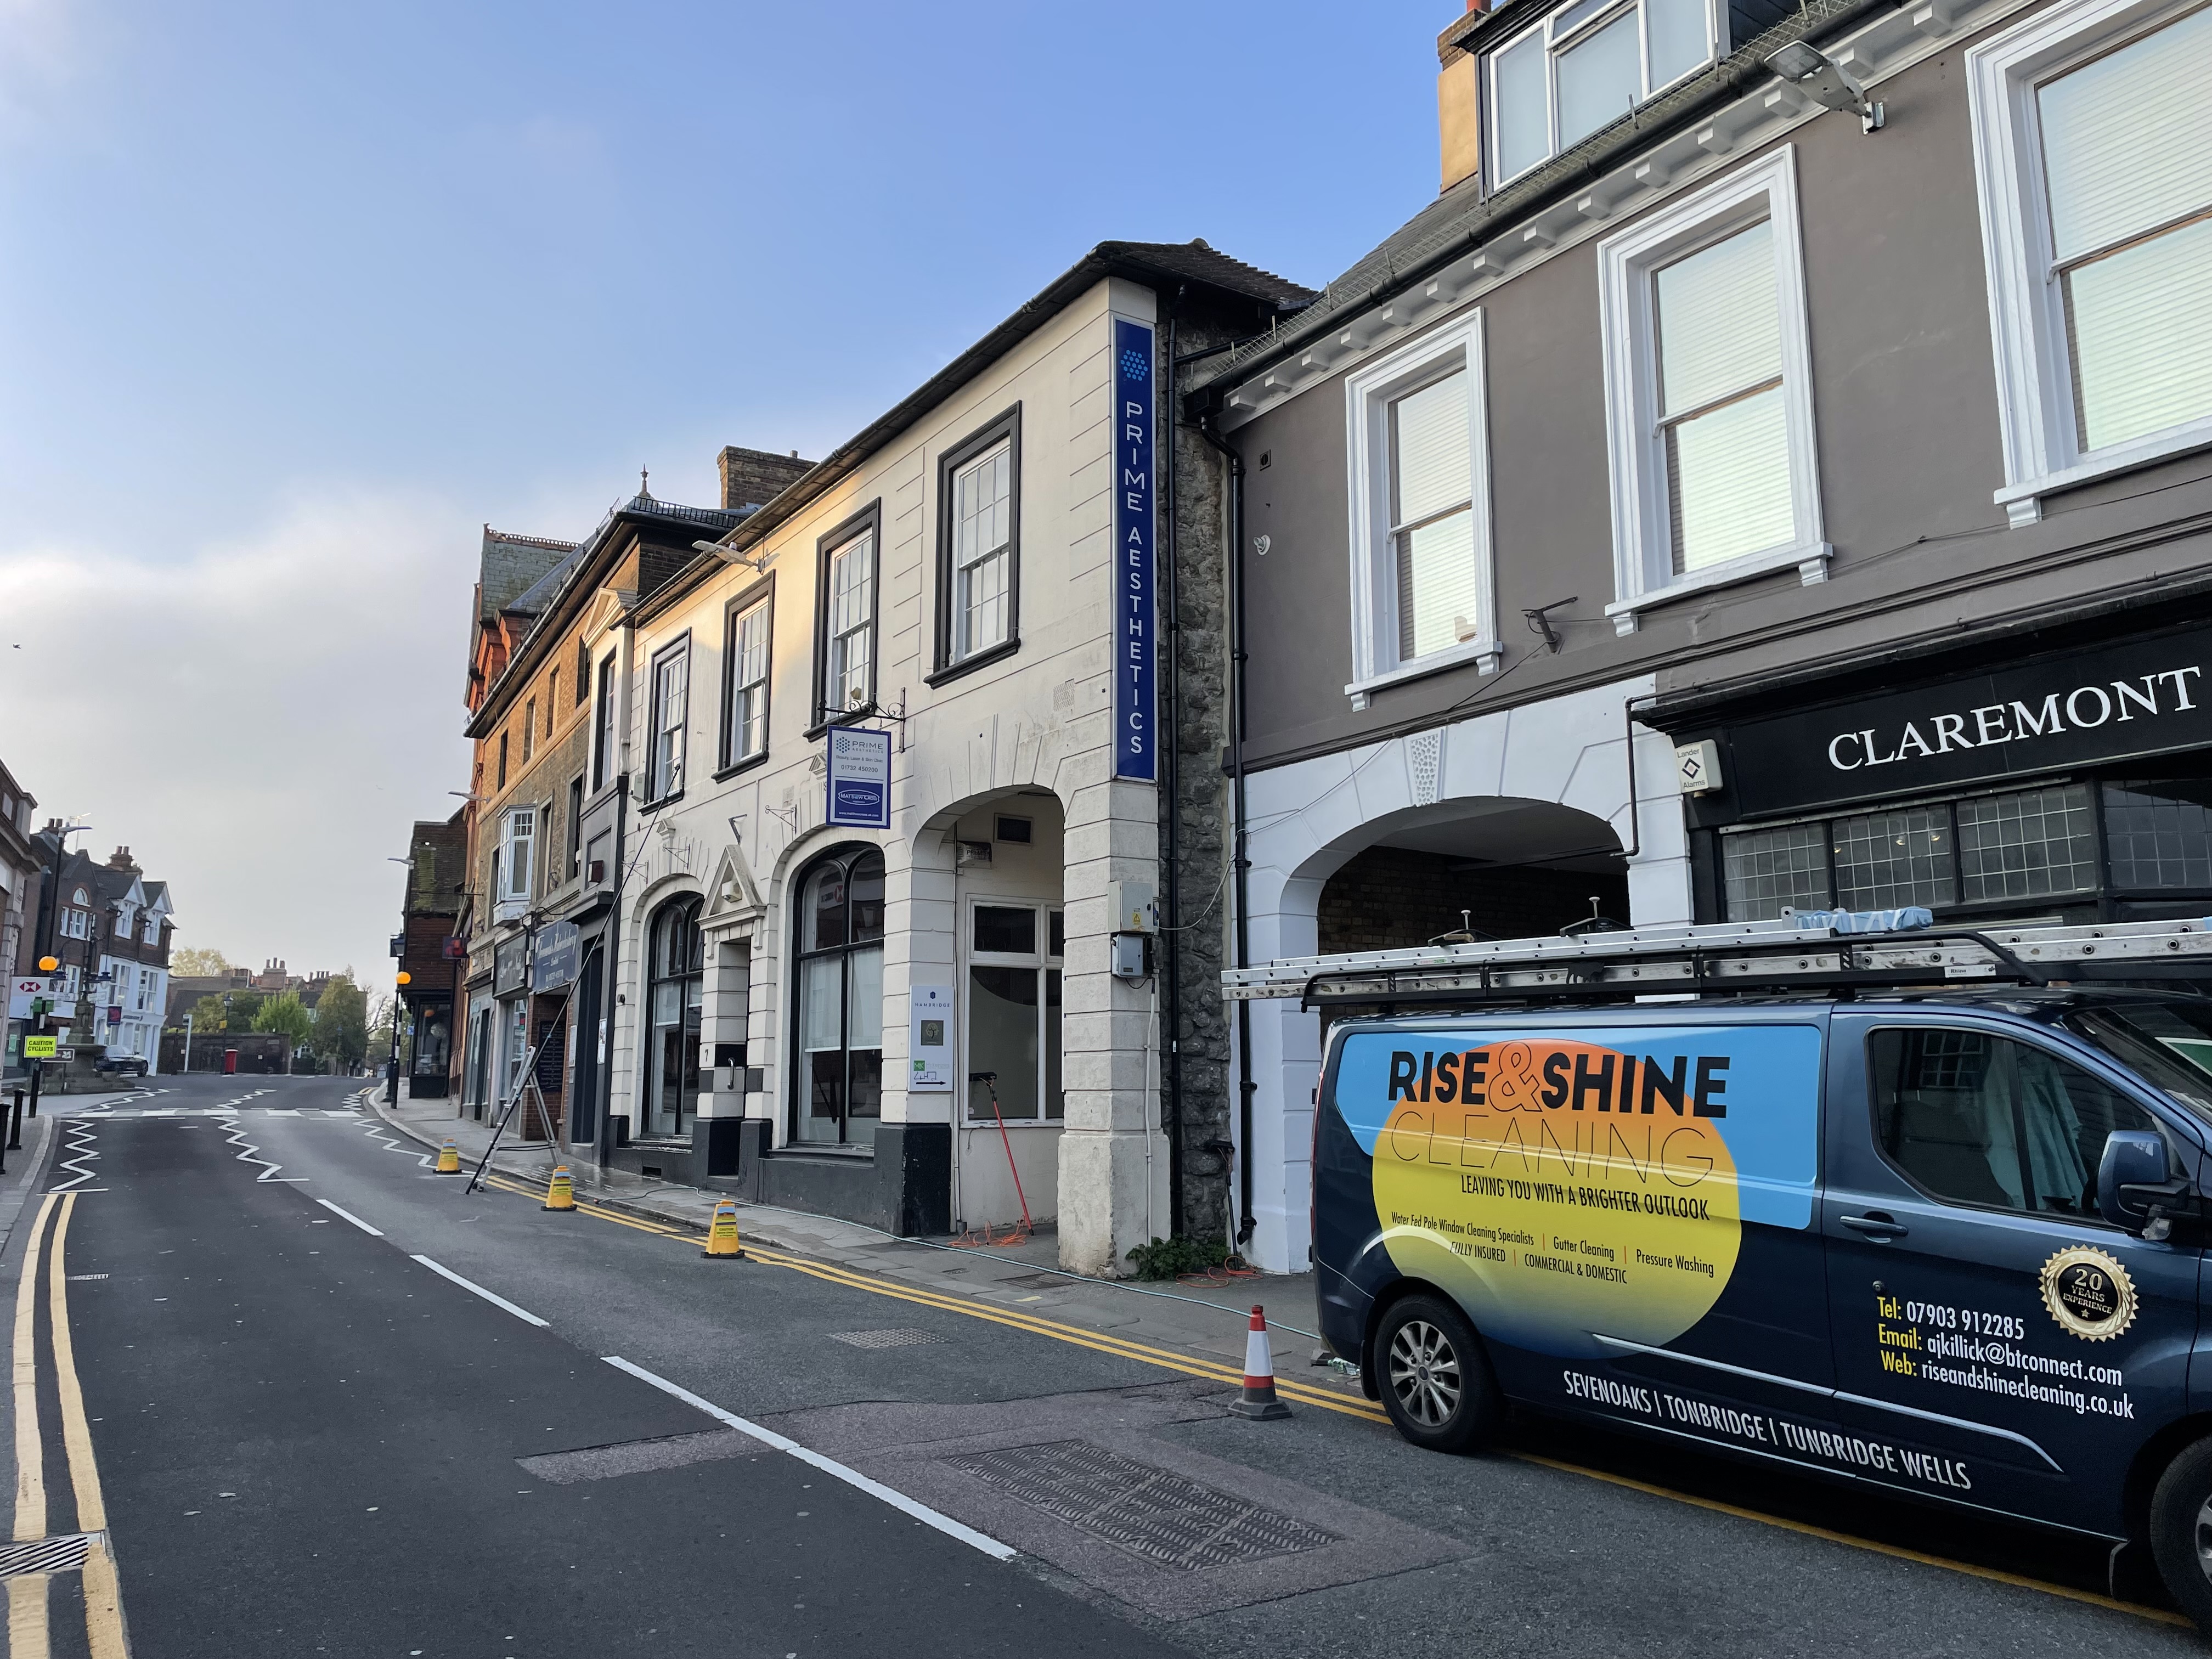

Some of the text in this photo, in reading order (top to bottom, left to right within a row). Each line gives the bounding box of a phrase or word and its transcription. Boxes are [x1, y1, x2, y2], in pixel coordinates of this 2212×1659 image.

[1125, 401, 1145, 754] PRIME AESTHETICS
[1828, 665, 2200, 770] CLAREMONT
[852, 741, 883, 750] PRIME
[1677, 748, 1700, 758] Lander
[1683, 780, 1706, 789] Alarms
[1391, 1111, 1714, 1187] CLEANING
[1461, 1175, 1711, 1221] LEAVING YOU WITH A BRIGHTER OUTLOOK
[1391, 1211, 1534, 1246] Water Fed Pole Window Cleaning Specialists
[1449, 1242, 1506, 1262] FULLY INSURED
[1554, 1236, 1614, 1262] Gutter Cleaning
[1637, 1249, 1714, 1278] Pressure Washing
[1525, 1253, 1627, 1284] COMMERCIAL & DOMESTIC
[2074, 1268, 2102, 1290] 20
[2063, 1293, 2112, 1314] EXPERIENCE
[2071, 1285, 2105, 1302] YEARS
[1877, 1296, 2024, 1340] Tel: 07903 912285
[1878, 1323, 2123, 1386] Email: ajkillick@btconnect.com
[1881, 1350, 2134, 1419] Web: riseandshinecleaning.co.uk
[1564, 1370, 1972, 1490] SEVENOAKS TONBRIDGE TUNBRIDGE WELLS
